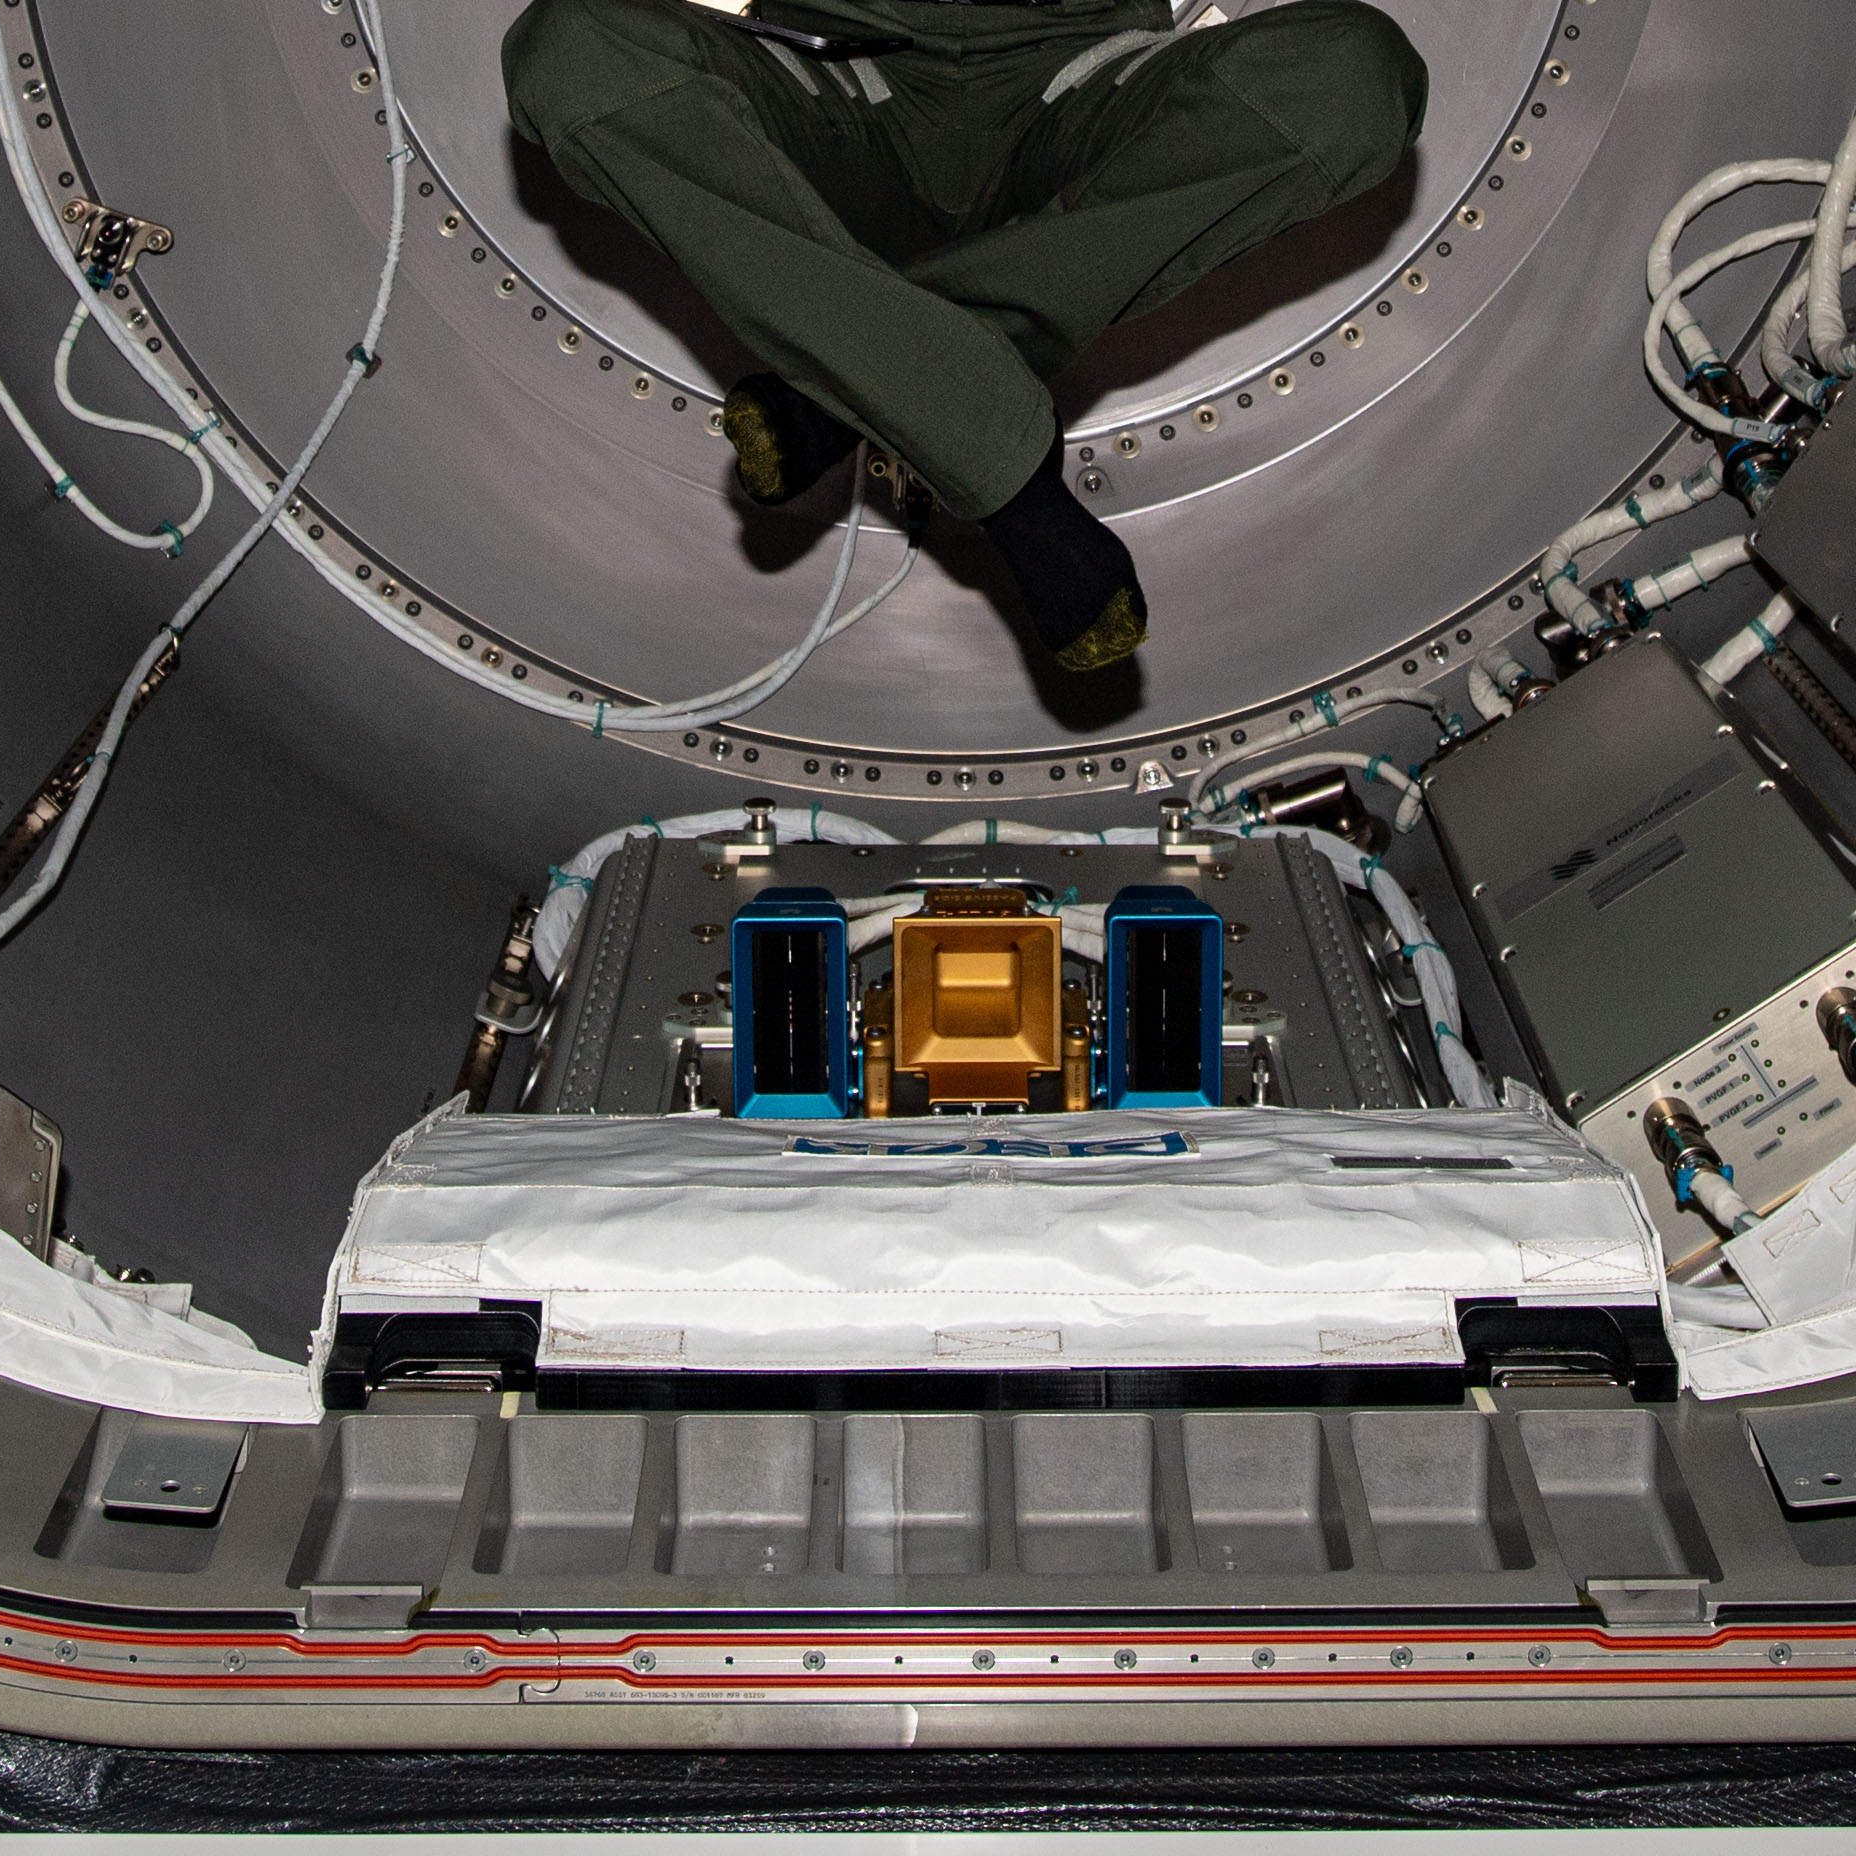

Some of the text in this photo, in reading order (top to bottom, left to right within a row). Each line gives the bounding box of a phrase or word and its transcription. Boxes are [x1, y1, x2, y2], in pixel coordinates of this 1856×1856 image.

[1605, 788, 1694, 847] Nanoracks
[1692, 1068, 1716, 1087] Node
[1704, 1085, 1729, 1104] PVGF
[1718, 1104, 1742, 1123] PVGF
[805, 1137, 1167, 1156] DECK
